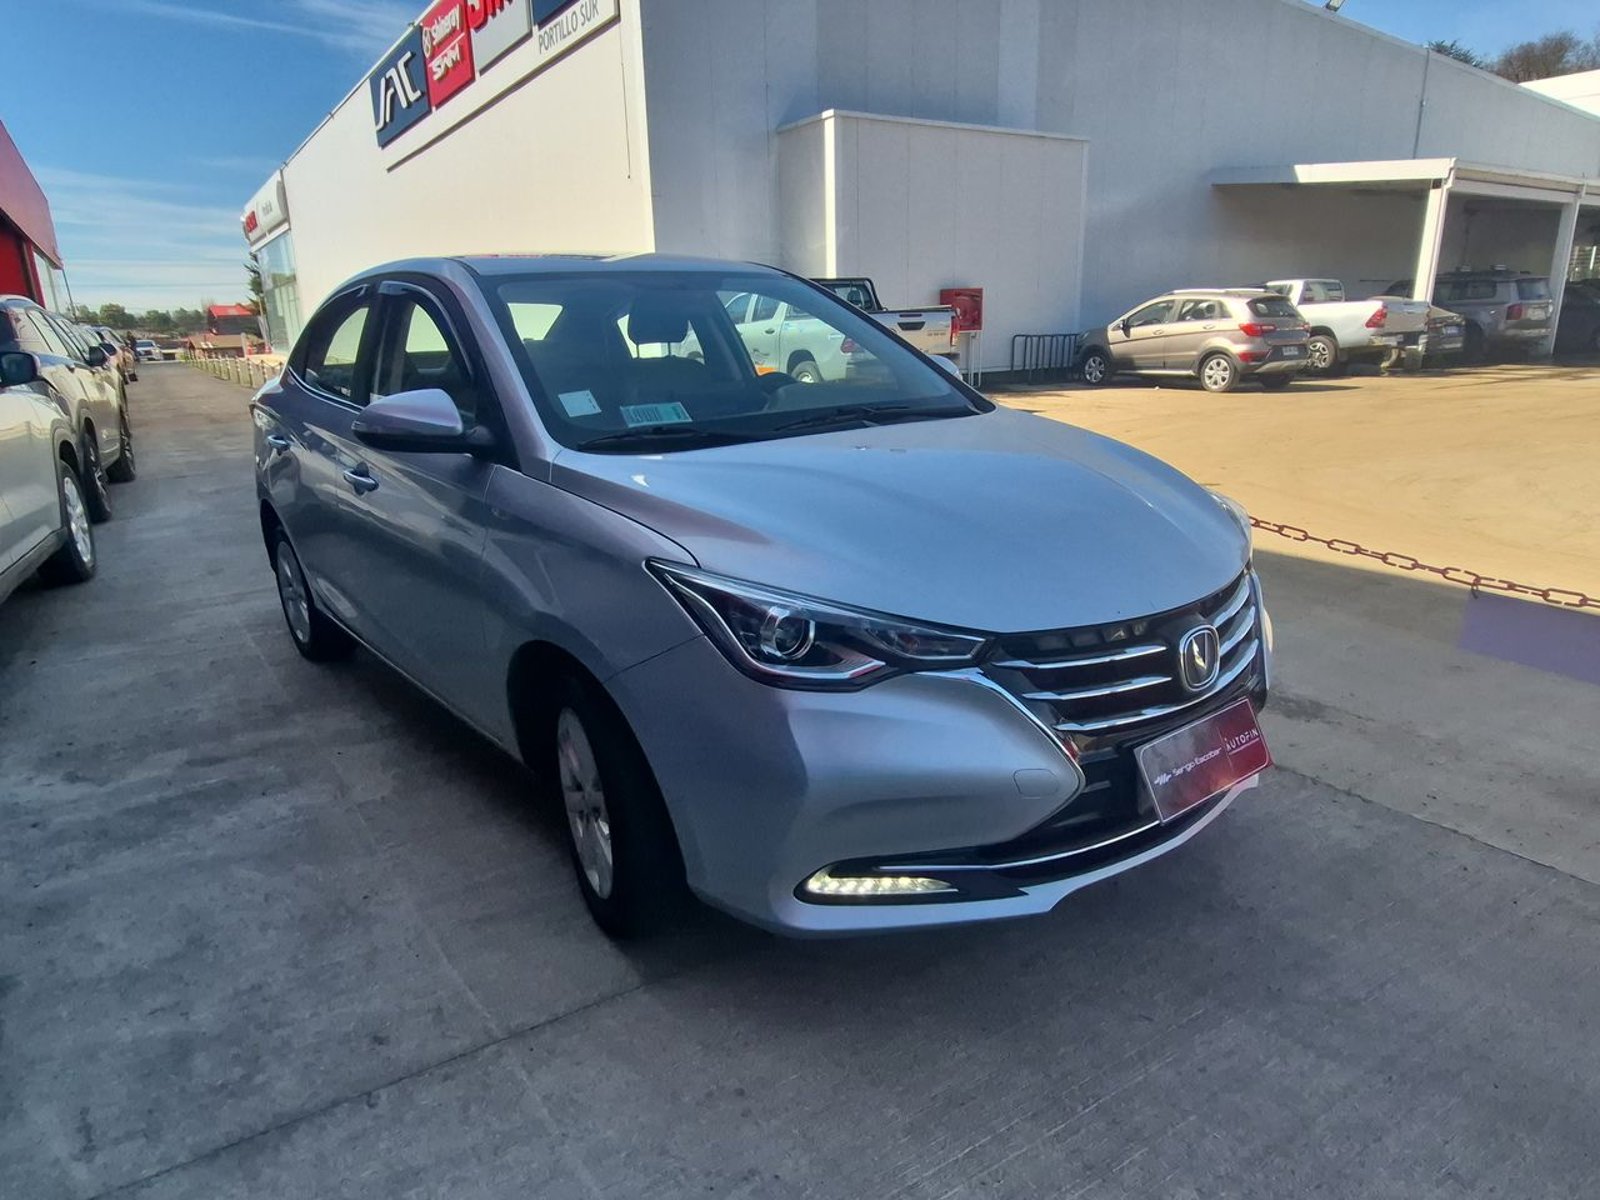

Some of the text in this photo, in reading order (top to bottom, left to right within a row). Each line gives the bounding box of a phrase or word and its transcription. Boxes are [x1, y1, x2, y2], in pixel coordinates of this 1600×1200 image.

[538, 10, 579, 55] PORTILLO
[580, 0, 600, 27] SUR
[431, 41, 461, 81] SWM
[374, 50, 422, 132] JAC
[1224, 728, 1260, 752] AUTOFIN
